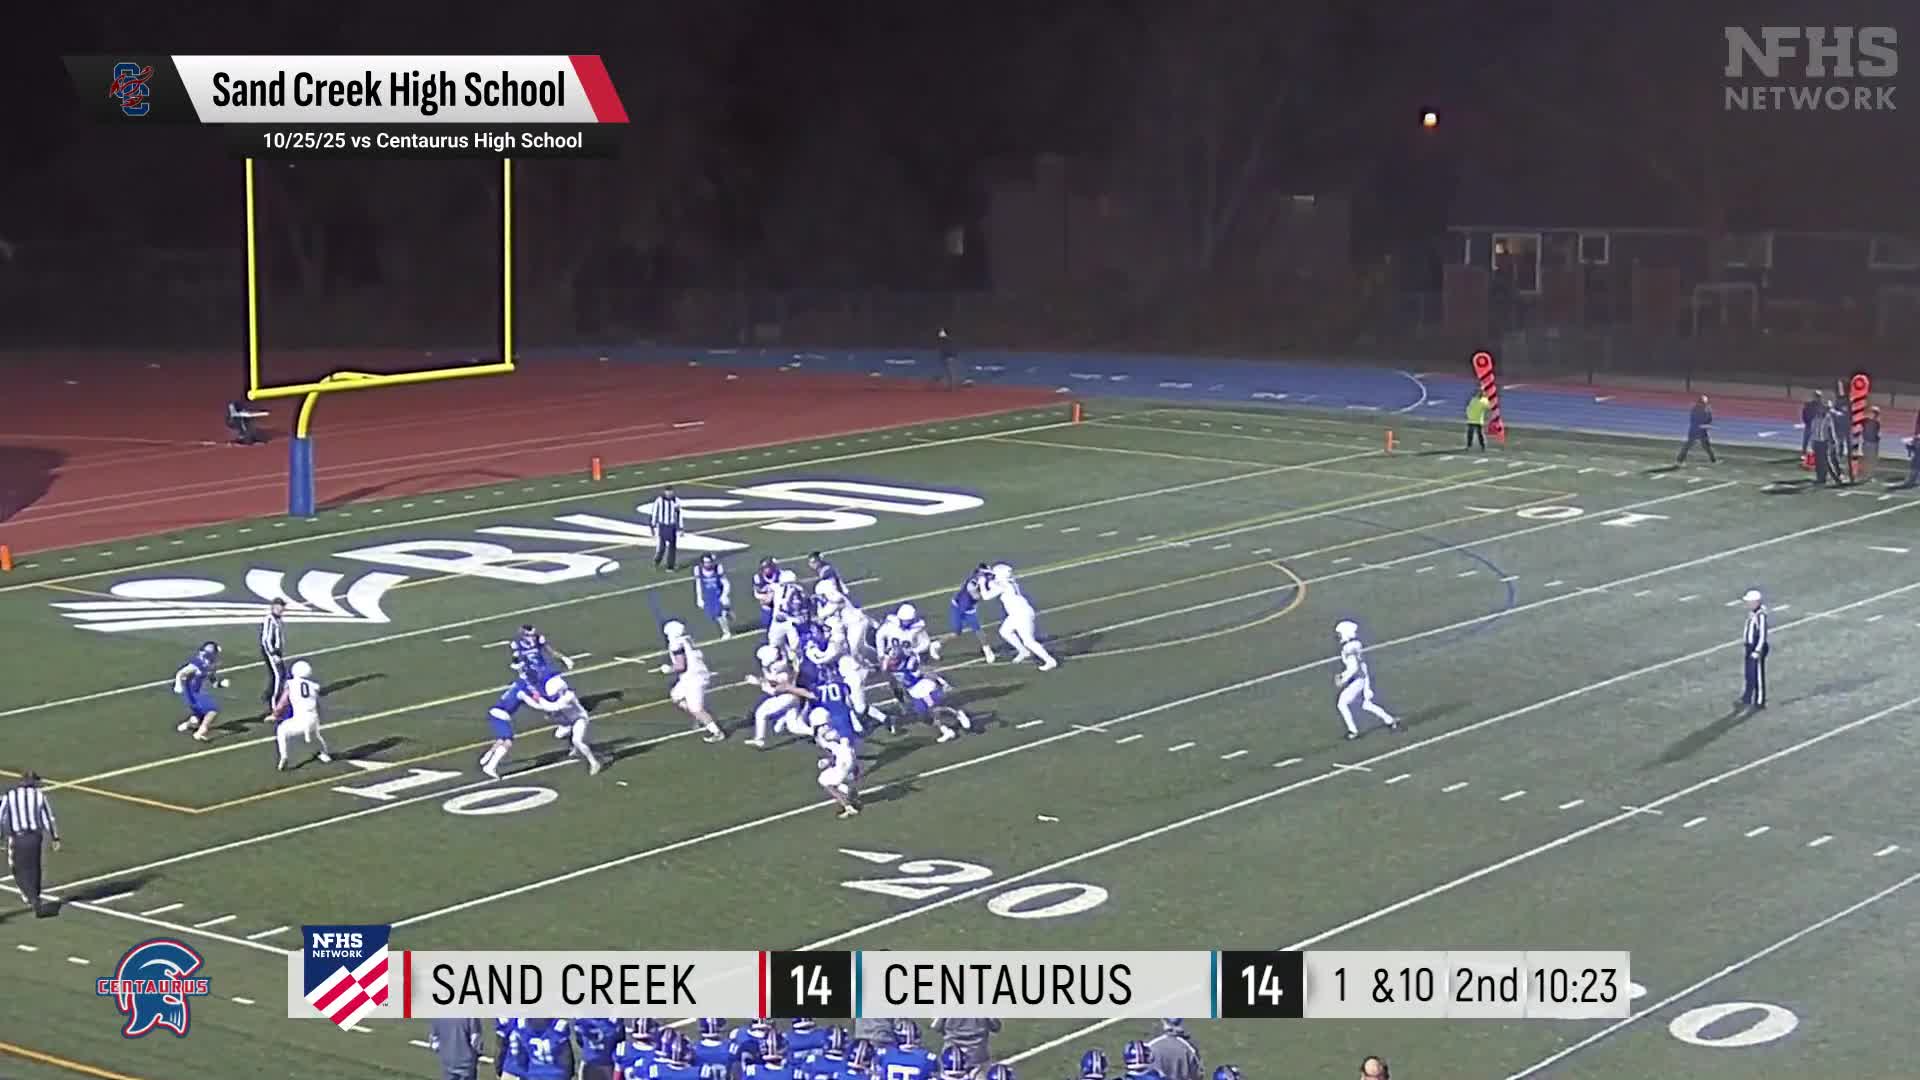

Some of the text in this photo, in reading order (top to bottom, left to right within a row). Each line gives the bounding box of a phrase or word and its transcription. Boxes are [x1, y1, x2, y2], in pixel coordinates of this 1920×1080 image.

[300, 681, 310, 698] 0
[819, 683, 841, 701] 70
[840, 858, 1109, 919] 20
